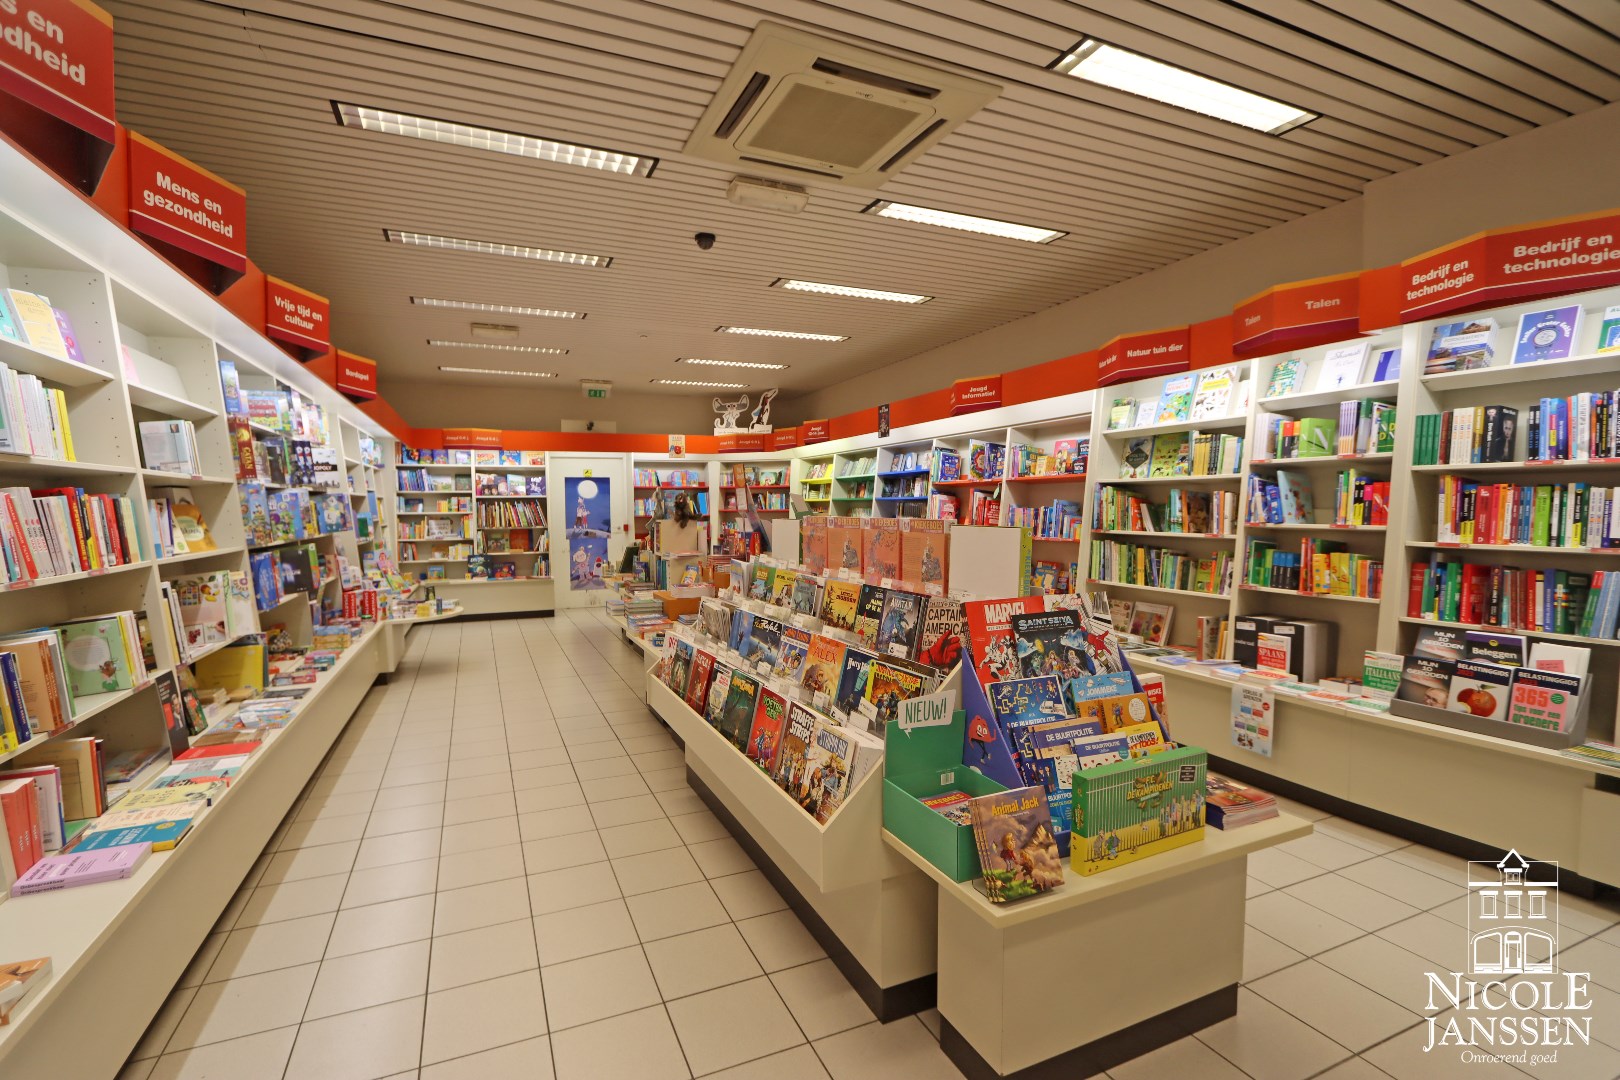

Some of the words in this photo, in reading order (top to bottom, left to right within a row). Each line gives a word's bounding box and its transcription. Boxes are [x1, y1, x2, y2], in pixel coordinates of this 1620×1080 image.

[27, 10, 64, 44] en
[0, 24, 86, 86] dheid
[156, 171, 200, 205] Mens
[203, 198, 222, 215] en
[143, 189, 233, 239] gezondheid
[1513, 236, 1582, 258] Bedrijf
[1586, 234, 1613, 247] en
[1503, 249, 1620, 274] technologie
[1412, 263, 1451, 286] Bedrijf
[1452, 259, 1469, 272] en
[1406, 272, 1474, 301] technologie
[274, 296, 296, 312] Vrije
[297, 304, 311, 318] tijd
[312, 311, 323, 322] en
[1305, 297, 1341, 310] Talen
[284, 314, 315, 330] cultuur
[1244, 313, 1261, 327] Talen
[1127, 348, 1152, 358] Natuur
[1153, 345, 1167, 354] tuin
[1168, 343, 1184, 352] dier
[969, 385, 988, 393] Jeugd
[242, 447, 253, 470] CATAN
[890, 597, 913, 611] AVATAR
[925, 622, 966, 635] AMERICA
[1434, 631, 1455, 639] MIJN
[812, 646, 837, 664] ALEX
[1258, 647, 1285, 658] SPAANS
[1472, 647, 1517, 660] Beleggen
[1418, 660, 1439, 668] MIJN
[1457, 663, 1510, 678] BELASTINGGIDS
[1518, 671, 1578, 687] BELASTINGGIDS
[1086, 684, 1117, 697] JOMMEKE
[1515, 687, 1549, 707] 365
[790, 706, 814, 732] STRAFFE
[905, 699, 947, 725] NIEUW!
[789, 721, 811, 744] STRIPS
[1046, 733, 1054, 741] DE
[1054, 727, 1094, 741] BUURTPOLITIE
[1092, 740, 1121, 750] BUURTPOLITIE
[1127, 791, 1135, 800] DE
[1135, 781, 1174, 798] KAMPIOENEN
[991, 799, 1020, 816] Animal
[1020, 796, 1040, 811] Jack
